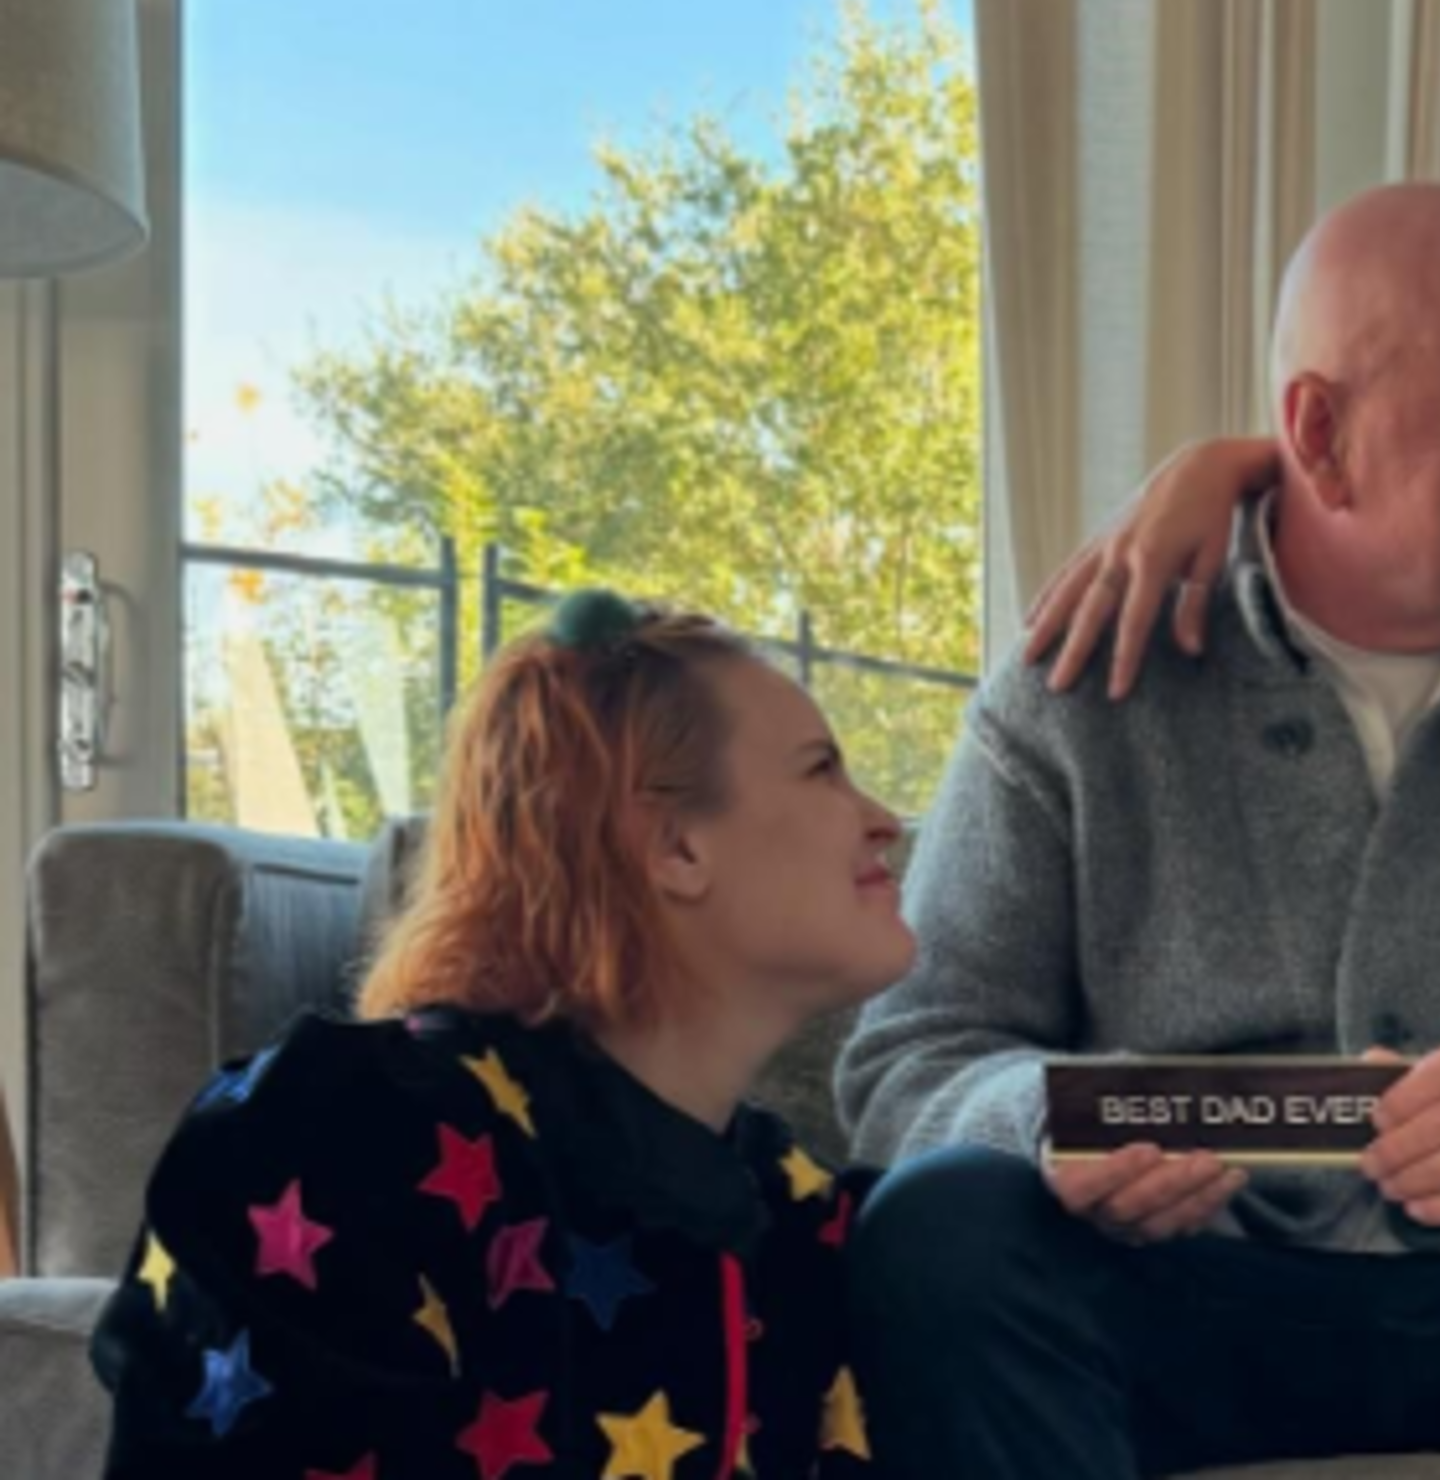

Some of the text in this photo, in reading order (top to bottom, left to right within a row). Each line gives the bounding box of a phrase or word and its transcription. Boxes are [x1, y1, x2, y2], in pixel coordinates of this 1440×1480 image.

[1101, 1095, 1380, 1125] BEST DAD EVER
